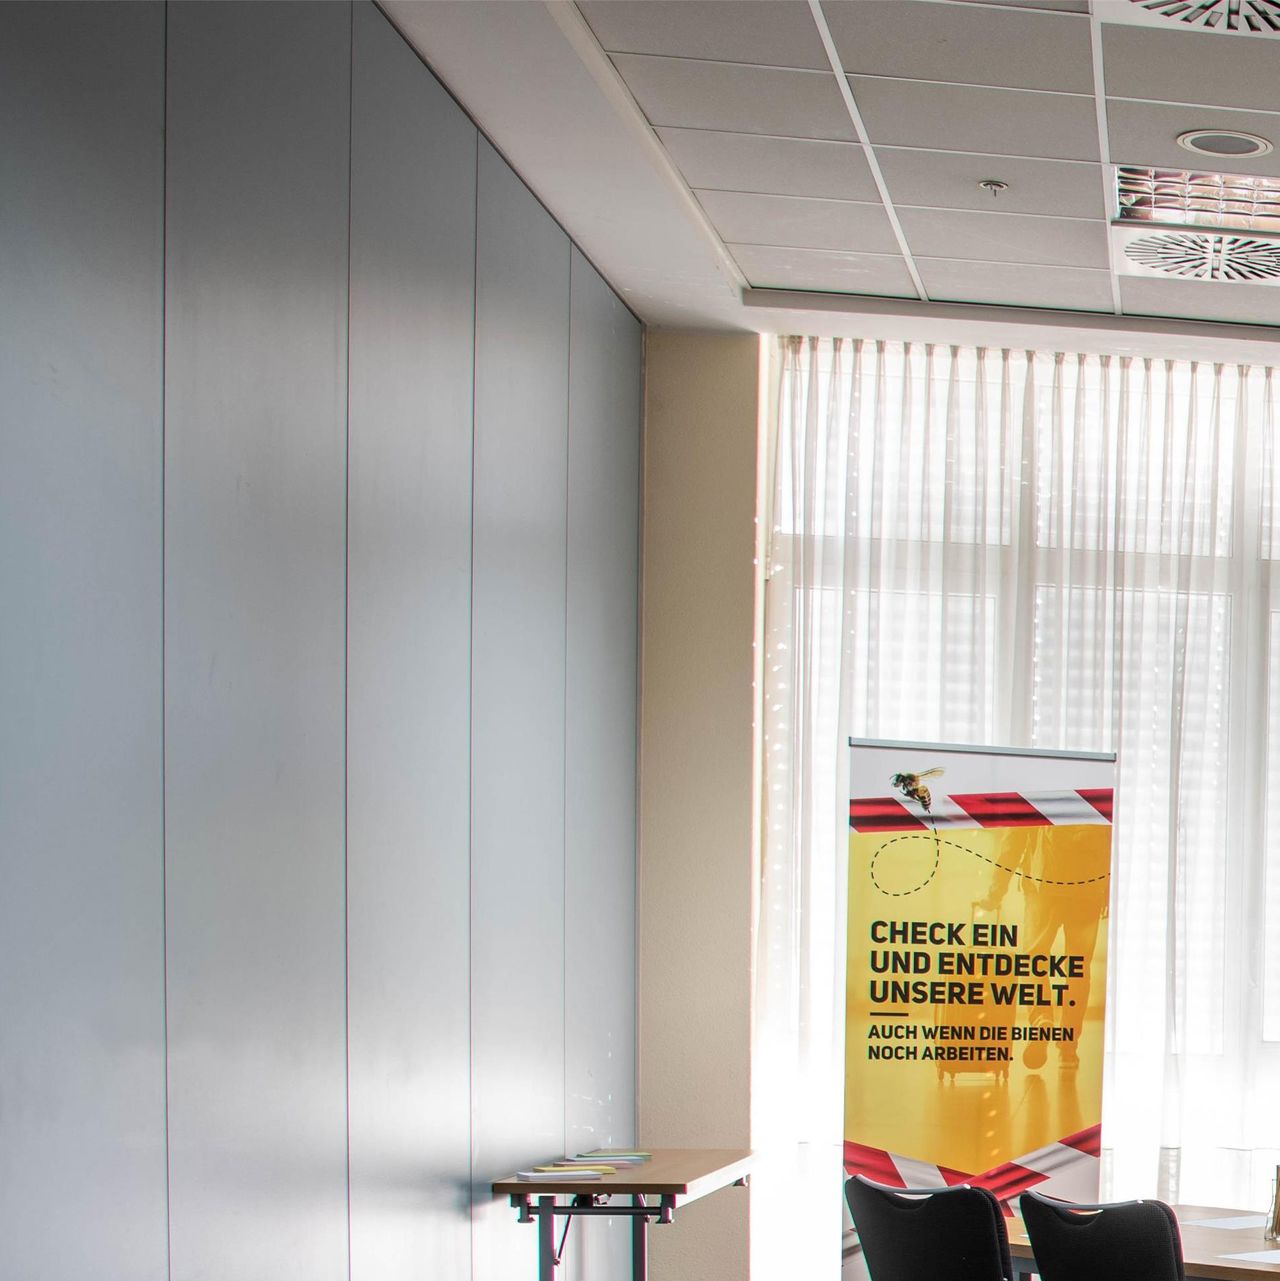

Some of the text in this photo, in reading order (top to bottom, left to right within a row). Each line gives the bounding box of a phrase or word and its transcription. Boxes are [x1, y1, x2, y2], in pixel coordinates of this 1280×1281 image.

[871, 920, 1018, 947] CHECK EIN
[870, 950, 1085, 978] UND ENTDECKE
[870, 980, 1076, 1007] UNSERE WELT.
[868, 1024, 1074, 1042] AUCH WENN DIE BIENEN
[868, 1046, 1014, 1062] NOCH ARBEITEN.
